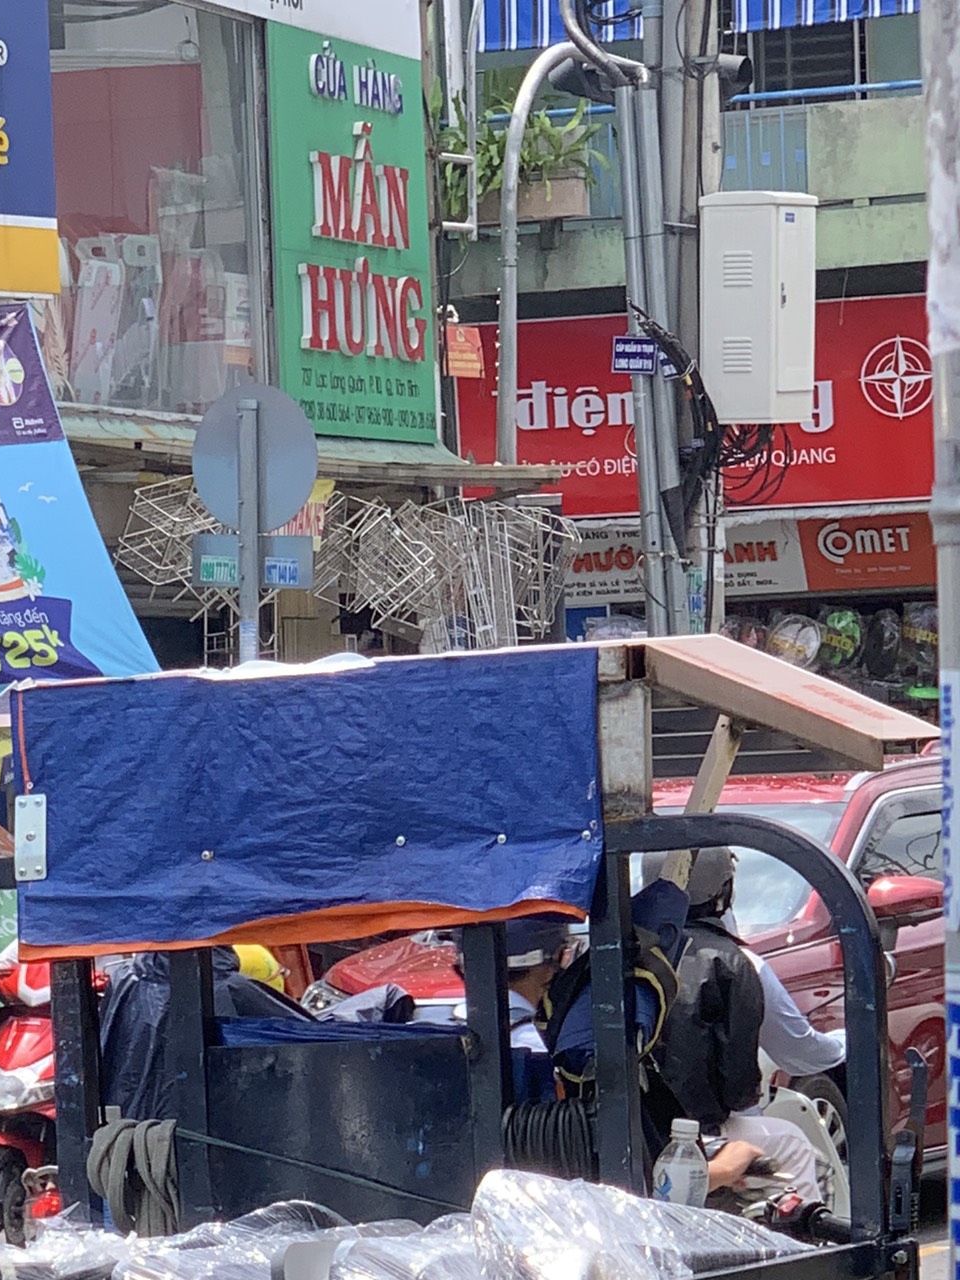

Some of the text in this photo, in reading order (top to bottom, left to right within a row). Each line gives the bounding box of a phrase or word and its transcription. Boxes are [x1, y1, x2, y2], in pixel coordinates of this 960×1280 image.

[309, 41, 403, 115] CỬA HÀNG
[309, 121, 410, 250] MẪN
[298, 257, 427, 362] HƯNG
[818, 522, 910, 564] COMET
[23, 607, 49, 626] đến
